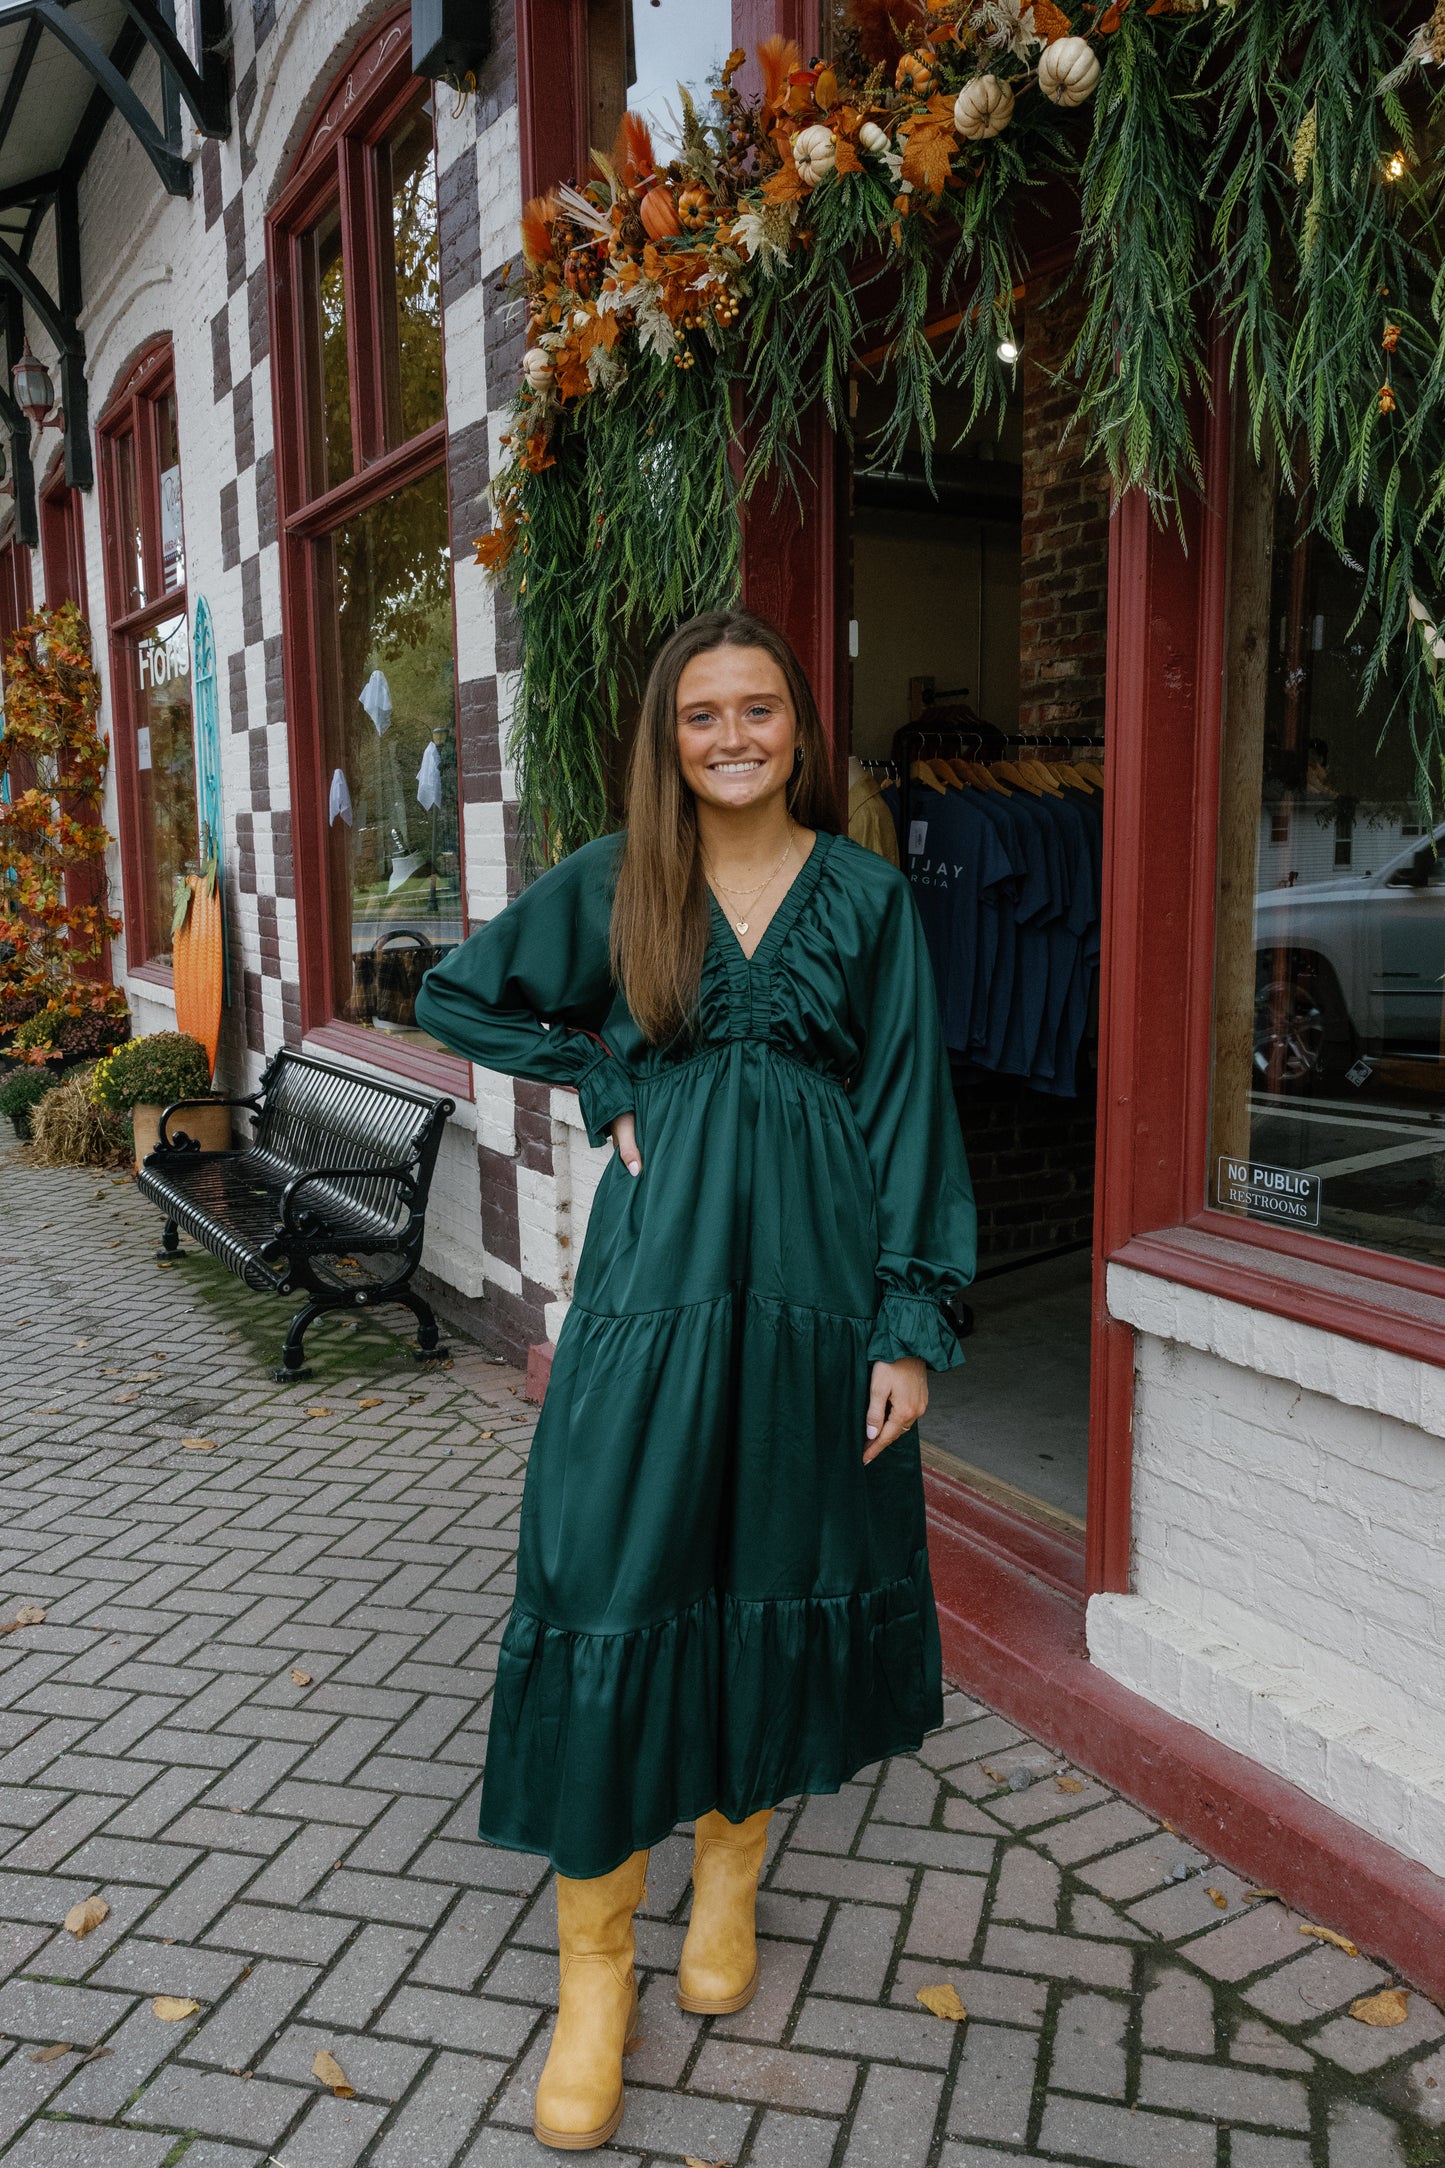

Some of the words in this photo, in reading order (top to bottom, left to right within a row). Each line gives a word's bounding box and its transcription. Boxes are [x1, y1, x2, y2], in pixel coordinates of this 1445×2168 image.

[1228, 1164, 1247, 1182] NO
[1253, 1169, 1310, 1195] PUBLIC
[1229, 1188, 1307, 1217] RESTROOMS
